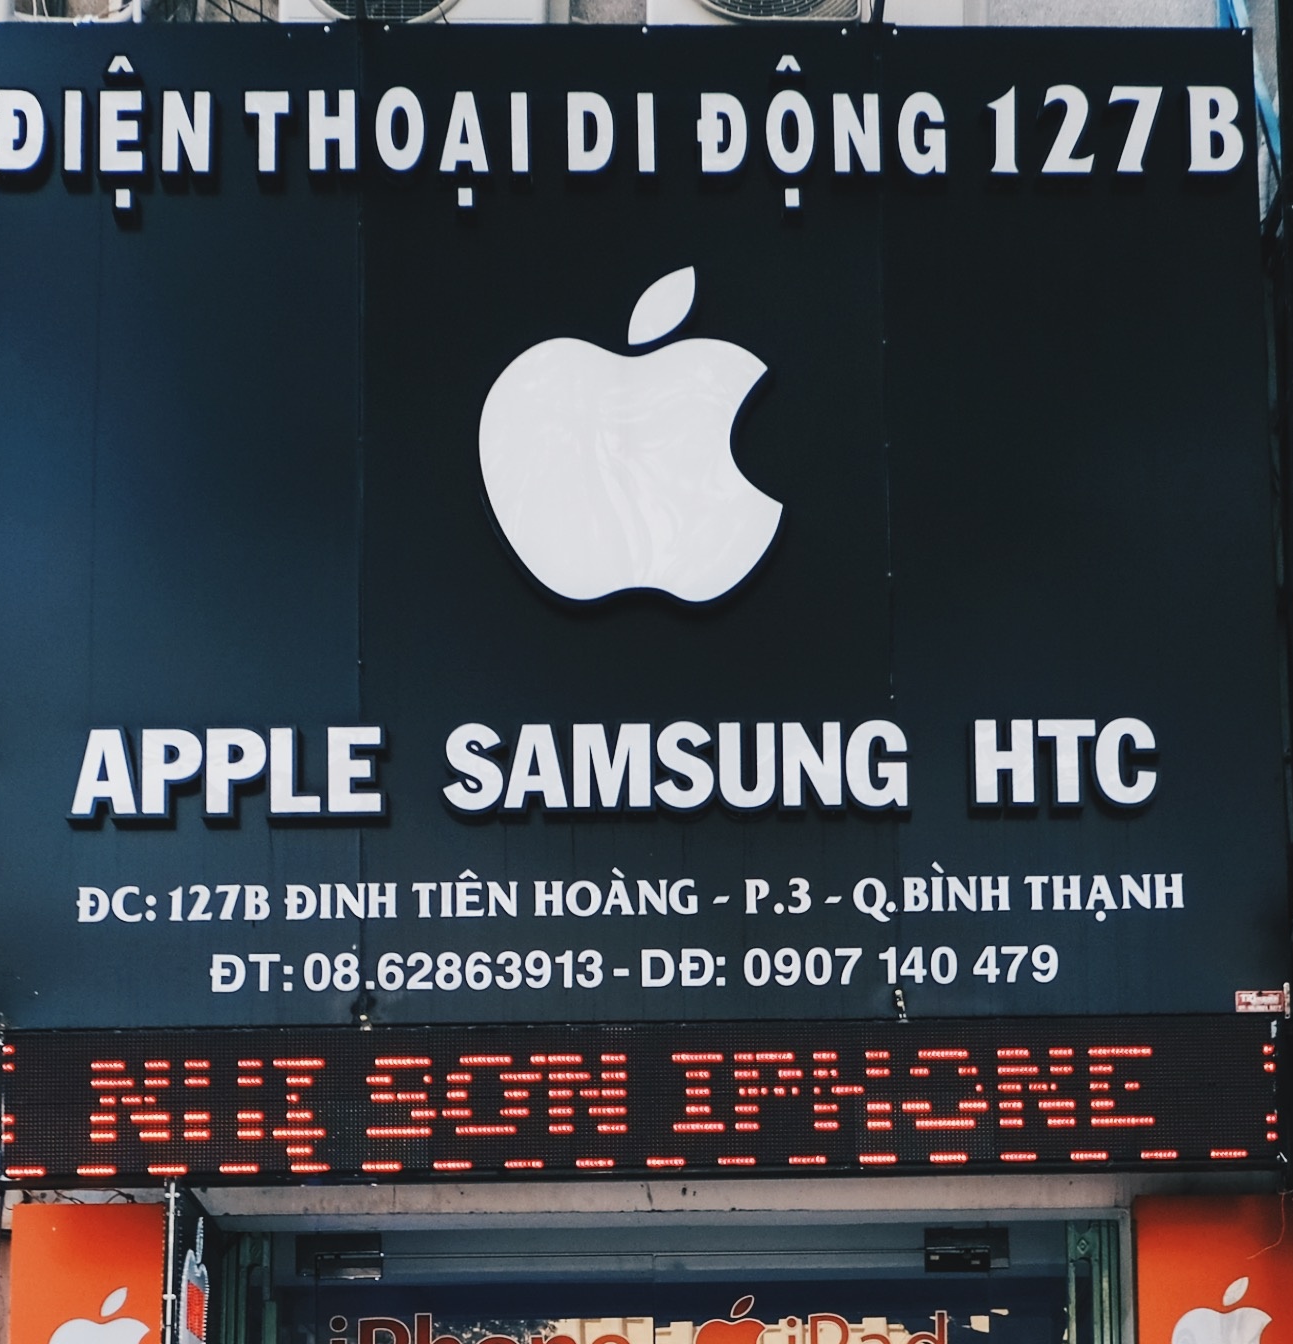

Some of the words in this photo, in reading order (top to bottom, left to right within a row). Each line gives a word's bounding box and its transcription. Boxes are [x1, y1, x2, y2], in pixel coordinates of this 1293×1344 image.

[245, 86, 529, 208] THOẠI
[566, 91, 656, 173] DI
[697, 54, 947, 208] ĐỘNG
[69, 727, 384, 816] APPLE
[442, 719, 909, 811] SAMSUNG
[974, 717, 1158, 806] HTC
[284, 882, 398, 921] ĐINH
[412, 869, 519, 920] TIÊN
[535, 864, 699, 918] HOÀNG
[1023, 872, 1185, 923] THẠNH
[742, 947, 863, 988] 0907
[877, 945, 958, 986] 140
[972, 944, 1061, 985] 479
[672, 1046, 1158, 1133] IPHONE
